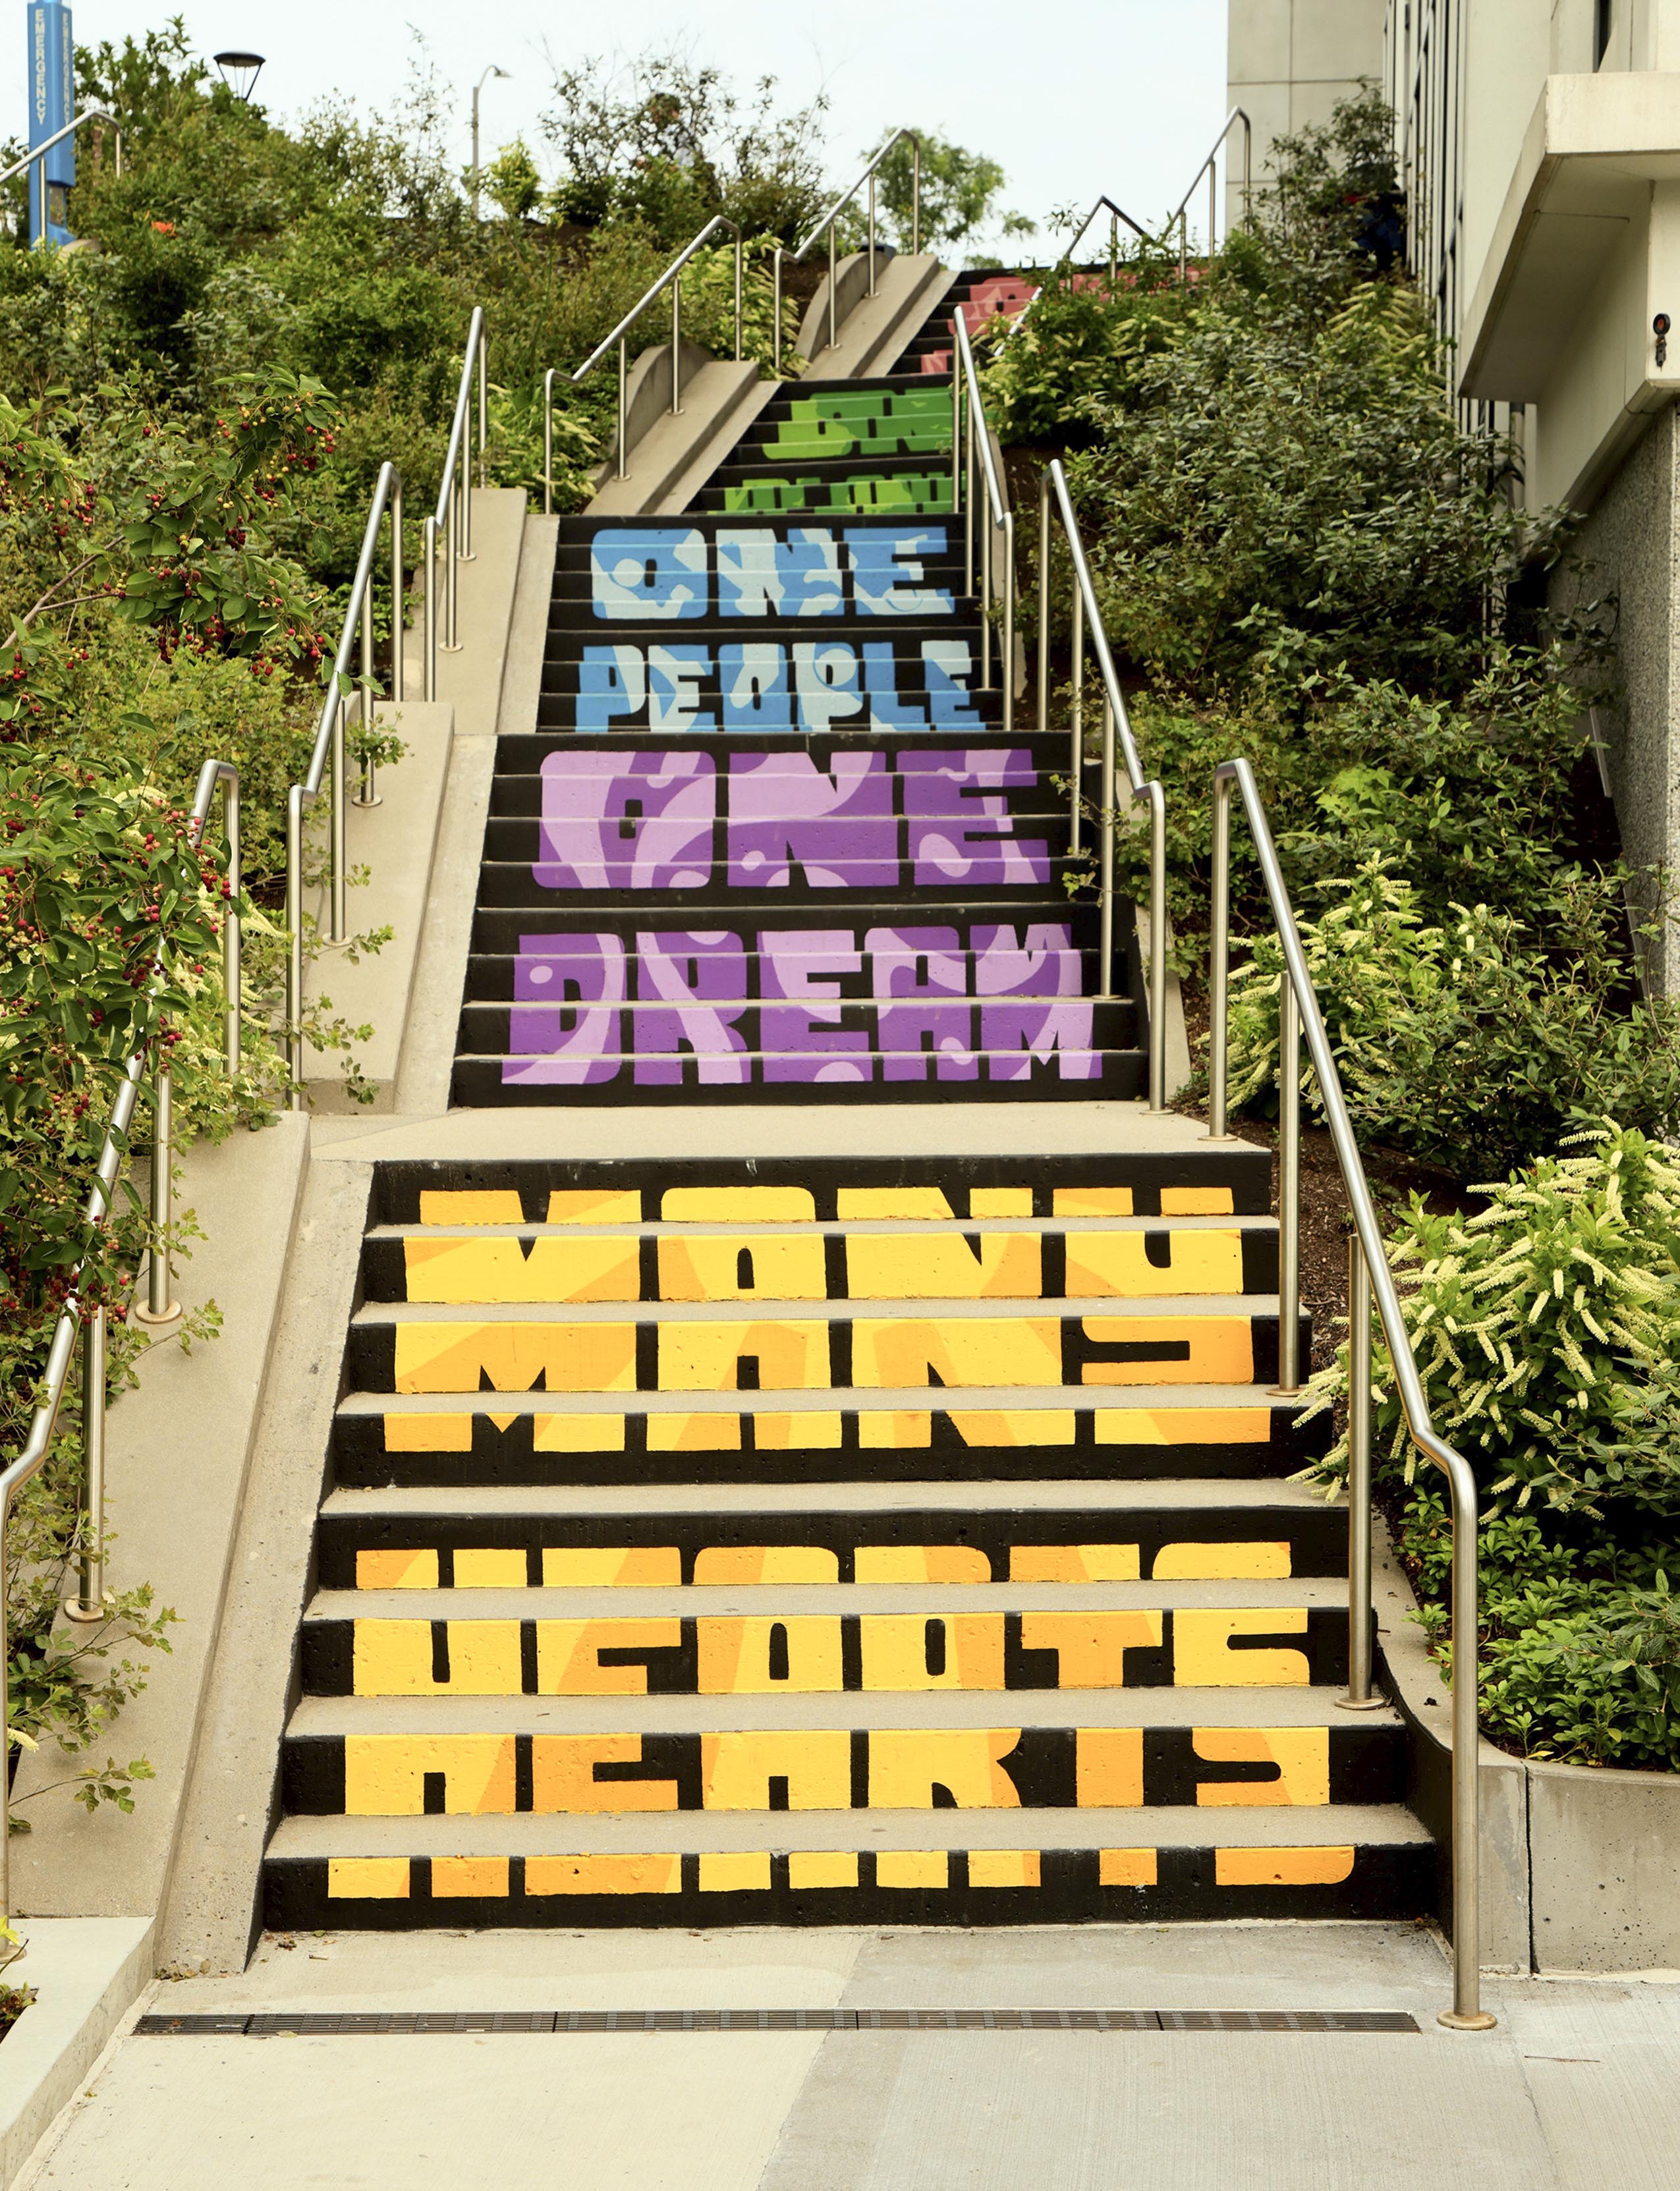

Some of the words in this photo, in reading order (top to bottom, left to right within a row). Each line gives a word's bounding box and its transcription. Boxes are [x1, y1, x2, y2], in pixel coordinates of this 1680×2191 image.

[35, 9, 46, 125] EMERGENCY
[591, 527, 955, 619] ONE
[575, 640, 986, 732] PEOPLE
[532, 749, 1051, 889] ONE
[501, 924, 1103, 1085] DREAM
[384, 1186, 1272, 1453] MANY
[327, 1541, 1356, 1899] HEARTS
